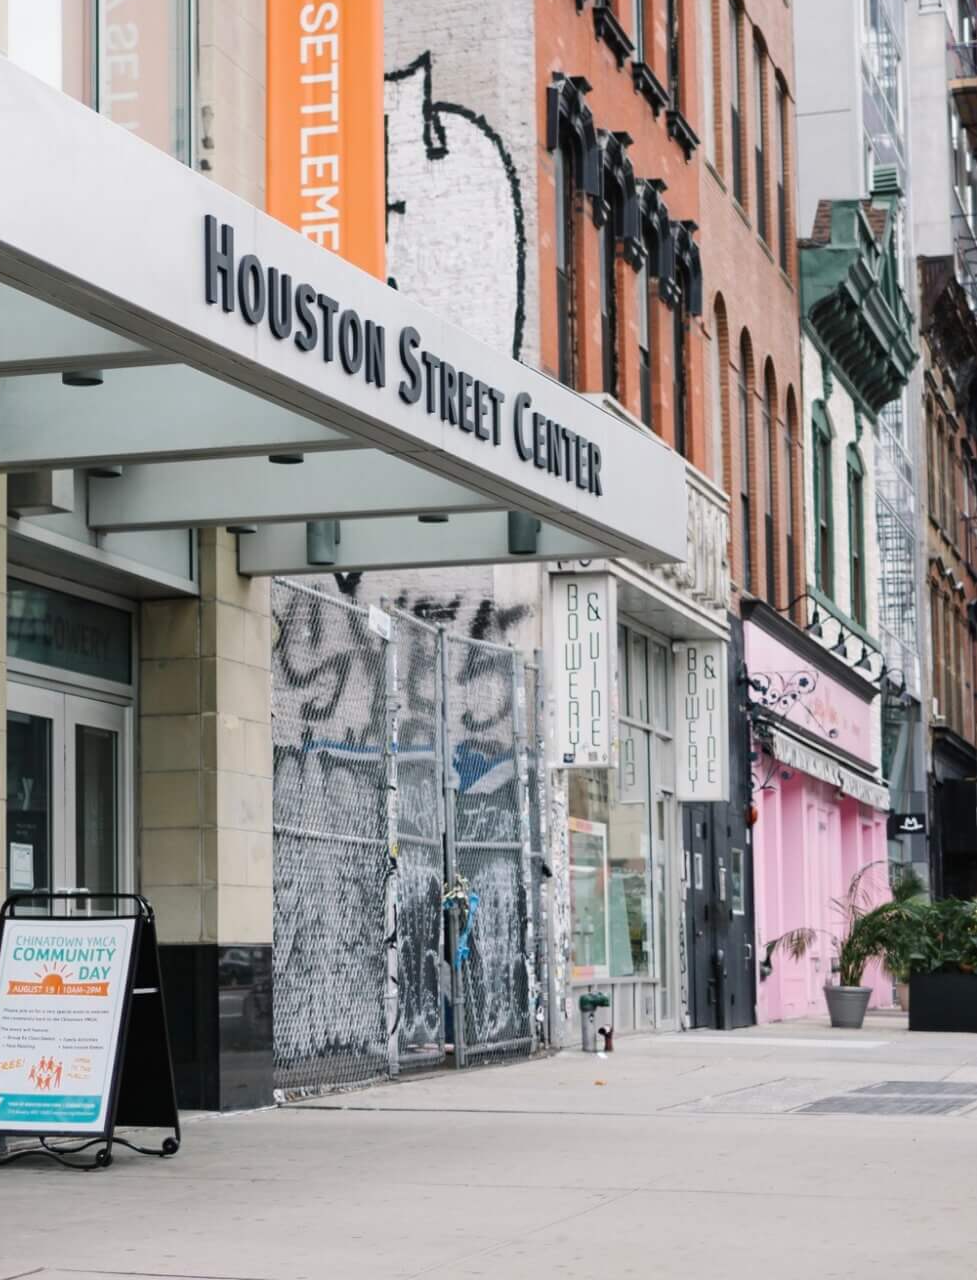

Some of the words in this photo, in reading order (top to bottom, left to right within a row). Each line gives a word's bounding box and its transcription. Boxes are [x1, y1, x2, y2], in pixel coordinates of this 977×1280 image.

[204, 214, 386, 389] HOUSTON
[399, 326, 505, 446] STREET
[513, 392, 604, 496] CENTER
[587, 592, 602, 622] &
[565, 584, 582, 756] BOWERY
[704, 655, 717, 680] &
[685, 647, 700, 793] BOWERY
[16, 935, 83, 947] CHINATOWN
[86, 936, 116, 947] YMCA
[12, 947, 116, 962] COMMUNITY
[79, 966, 110, 980] DAY
[12, 985, 42, 993] AUGUST
